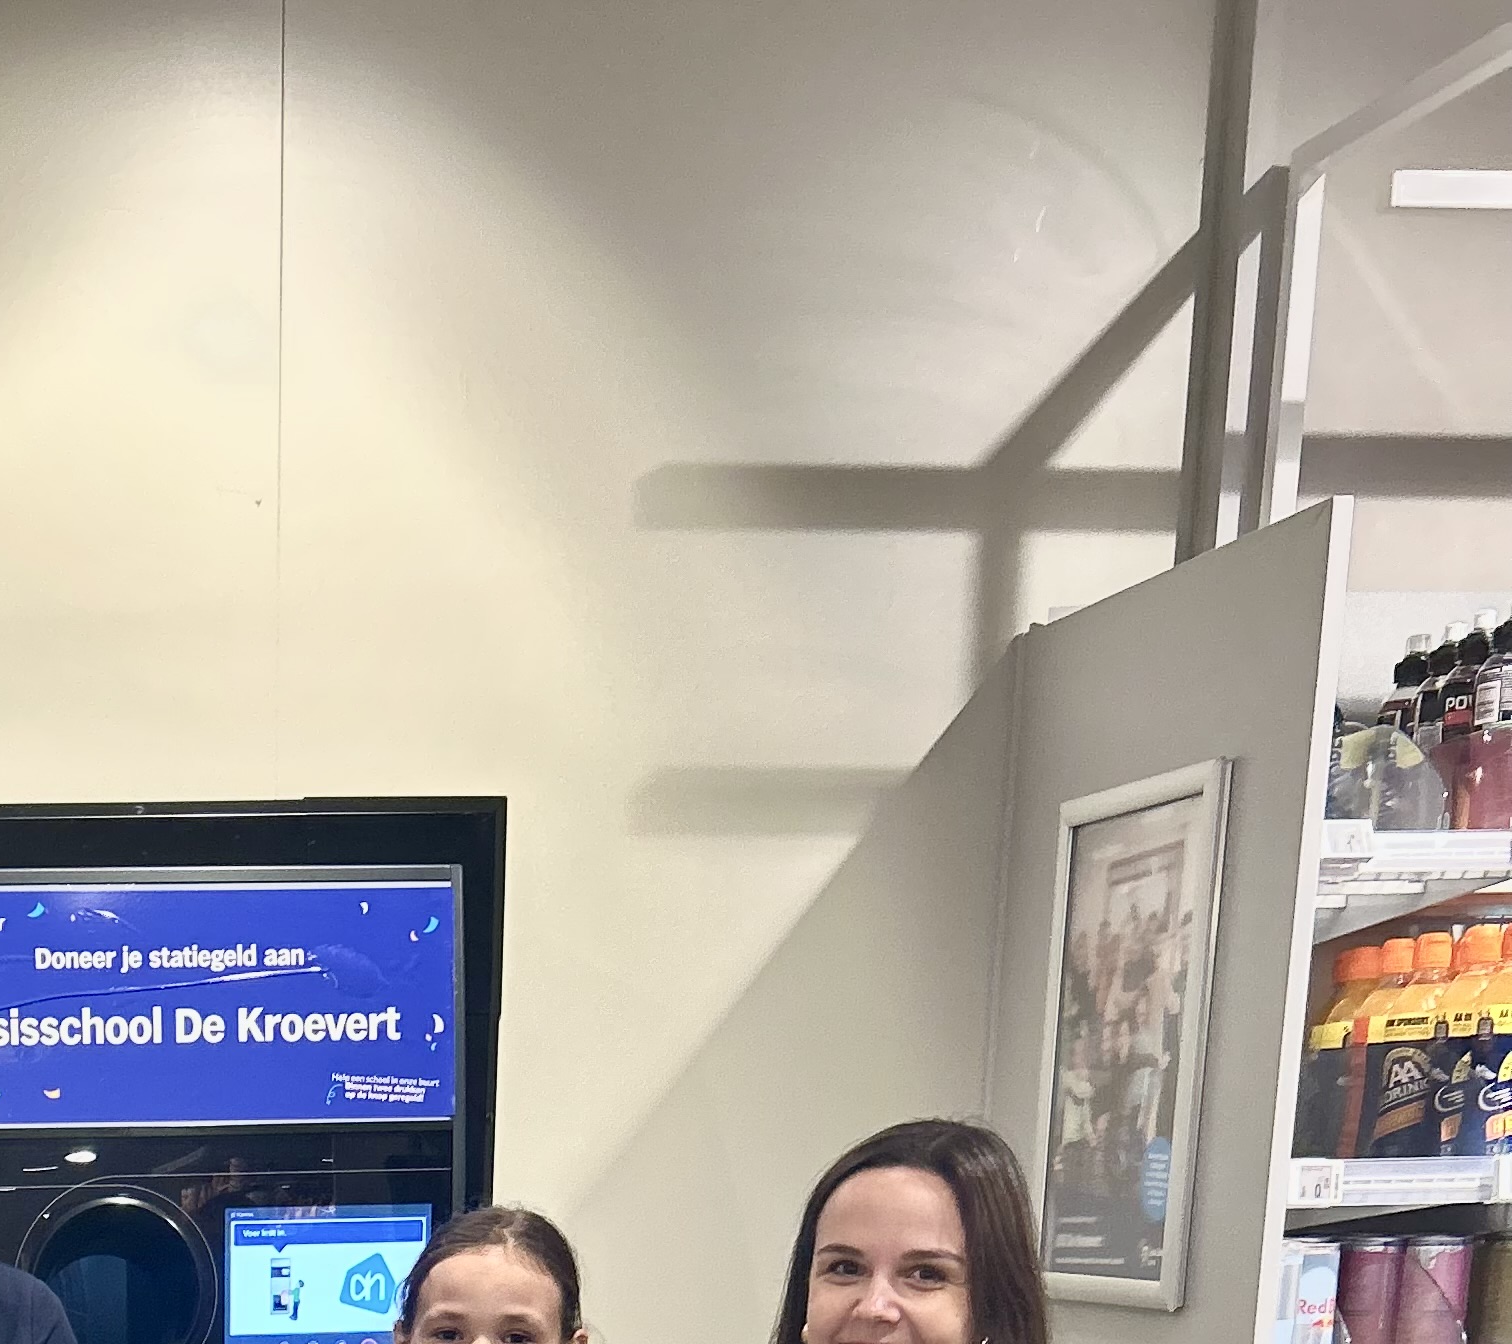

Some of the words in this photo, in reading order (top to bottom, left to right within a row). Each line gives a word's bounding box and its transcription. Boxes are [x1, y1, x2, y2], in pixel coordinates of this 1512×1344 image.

[35, 947, 115, 970] Doneer
[121, 946, 143, 974] je
[148, 943, 257, 970] statiegeld
[263, 947, 305, 967] aan
[176, 1008, 225, 1044] De
[238, 1005, 402, 1043] Kroevert
